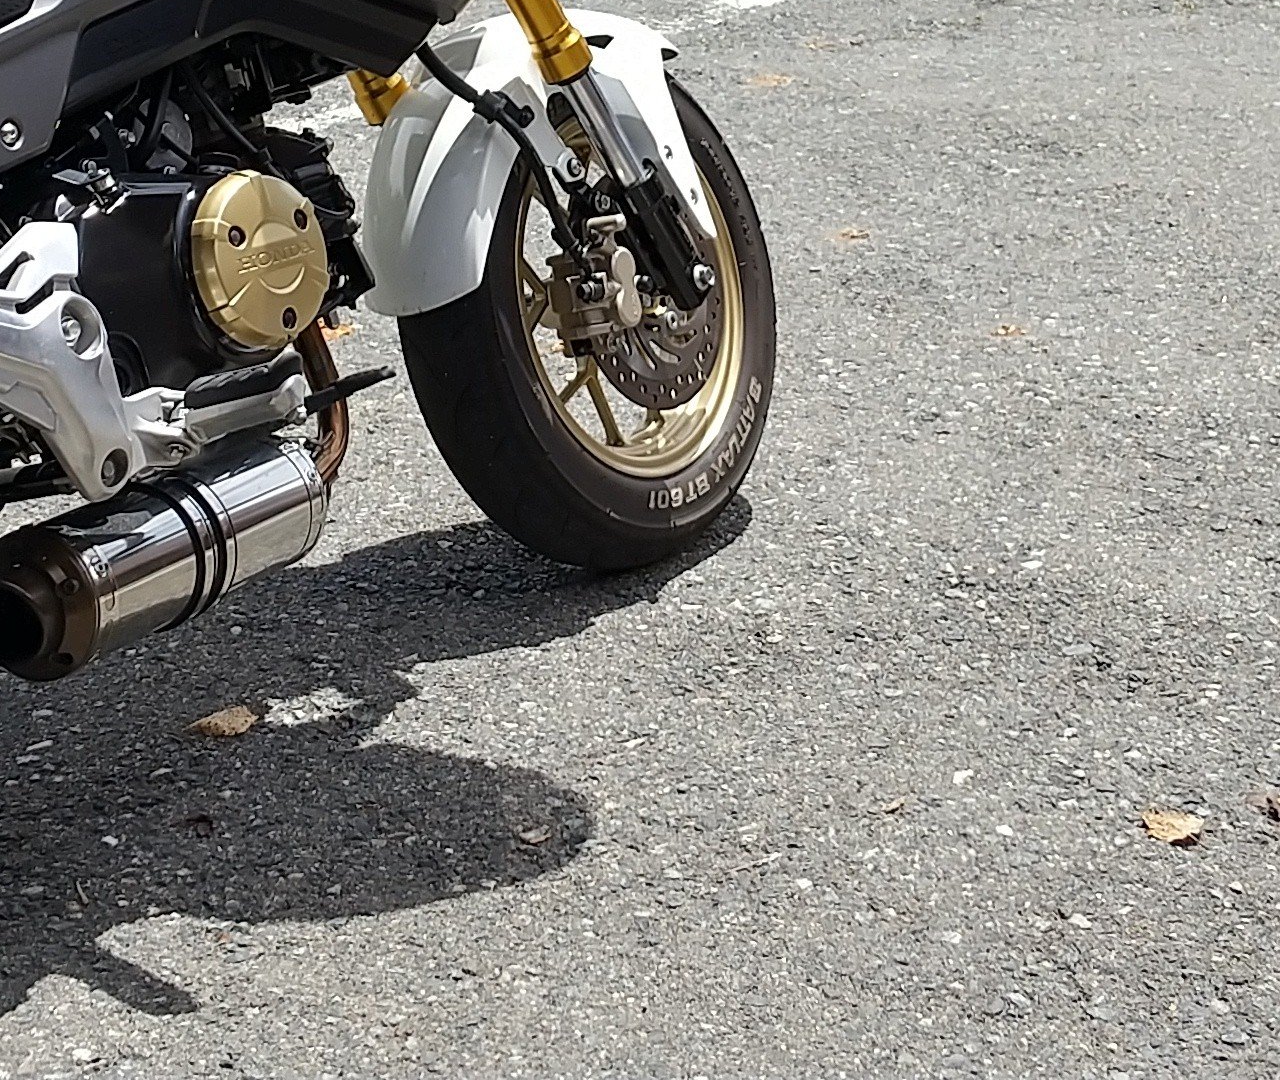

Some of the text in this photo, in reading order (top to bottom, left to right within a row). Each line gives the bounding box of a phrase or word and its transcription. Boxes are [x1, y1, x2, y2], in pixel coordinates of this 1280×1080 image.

[236, 240, 316, 276] HONDA
[647, 376, 763, 510] BATTLAX BT601
